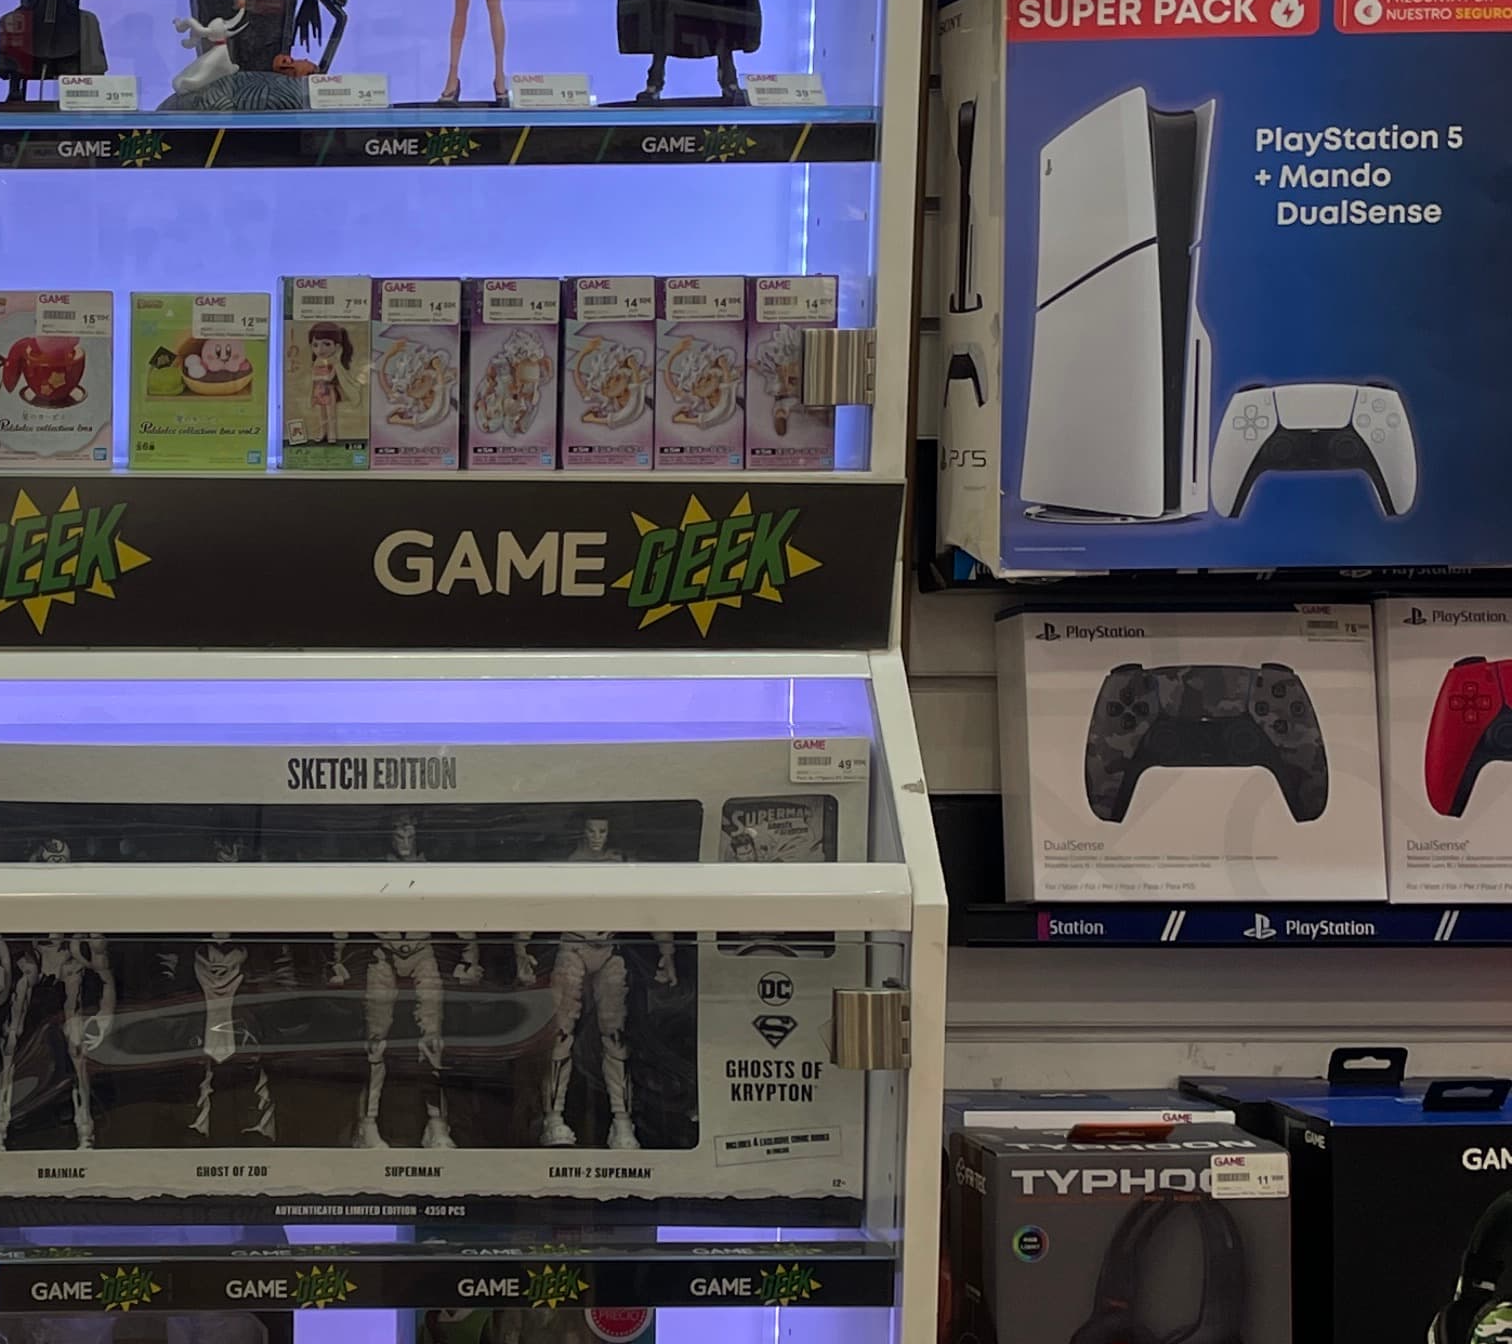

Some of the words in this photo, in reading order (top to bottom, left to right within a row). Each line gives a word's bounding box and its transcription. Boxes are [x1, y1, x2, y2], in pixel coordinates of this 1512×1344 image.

[1388, 8, 1452, 21] NUESTRO
[1455, 7, 1512, 20] SEGURO
[58, 140, 111, 157] GAME
[365, 139, 419, 156] GAME
[642, 136, 696, 153] GAME
[1256, 127, 1439, 157] PlayStation
[1447, 128, 1463, 149] 5
[1280, 164, 1392, 188] Mando
[1277, 201, 1442, 226] DualSense
[384, 282, 416, 293] GAME
[195, 297, 227, 307] GAME
[374, 530, 606, 597] GAME
[627, 509, 800, 608] GEEK
[1066, 625, 1144, 639] PlayStation
[793, 740, 826, 750] GAME
[289, 757, 367, 791] SKETCH
[374, 755, 456, 790] EDITION
[1286, 920, 1374, 937] PlayStation
[760, 978, 792, 1000] DC
[726, 1060, 795, 1079] GHOSTS
[801, 1061, 823, 1078] OF
[731, 1083, 813, 1102] KRYPTON
[1214, 1157, 1245, 1167] GAME
[196, 1166, 229, 1177] GHOST
[233, 1166, 244, 1177] OF
[248, 1166, 268, 1177] ZOD
[385, 1166, 441, 1177] SUPERMAN
[595, 1167, 651, 1178] SUPERMAN
[1011, 1169, 1212, 1194] TYPHO
[275, 1205, 343, 1216] AUTHENTICATED
[31, 1280, 92, 1301] GAME
[690, 1278, 751, 1296] GAME
